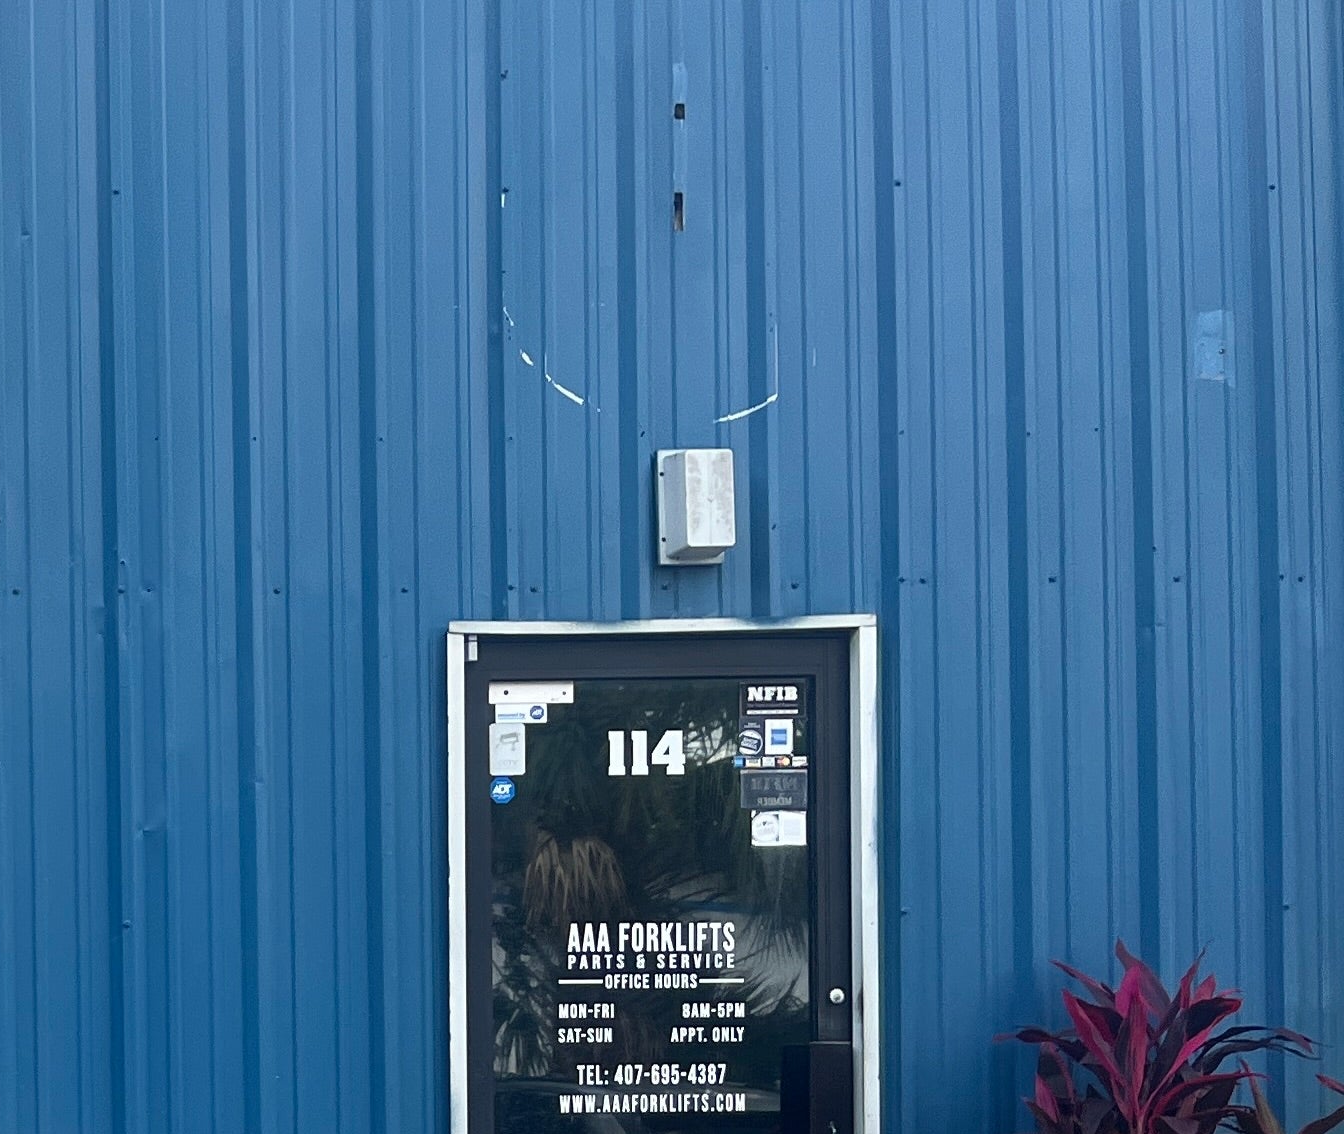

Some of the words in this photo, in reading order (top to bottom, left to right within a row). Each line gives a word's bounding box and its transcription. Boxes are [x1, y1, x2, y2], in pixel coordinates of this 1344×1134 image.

[747, 686, 798, 702] NFIB
[608, 730, 686, 776] 114
[492, 783, 512, 795] ADT
[567, 922, 610, 953] AAA
[618, 922, 735, 953] FORKLIFTS
[567, 954, 625, 970] PARTS
[636, 955, 646, 969] &
[656, 953, 735, 969] SERVICE
[604, 974, 650, 990] OFFICE
[654, 973, 698, 989] HOURS
[558, 1003, 615, 1019] MON-FRI
[682, 1003, 745, 1019] 8AM-5PM
[558, 1027, 613, 1043] SAT-SUN
[670, 1027, 708, 1043] APPT.
[712, 1027, 745, 1043] ONLY
[576, 1065, 609, 1086] TEL:
[613, 1063, 727, 1086] 407-695-4387
[559, 1094, 746, 1114] WWW.AAAFORKLIFTS.COM
